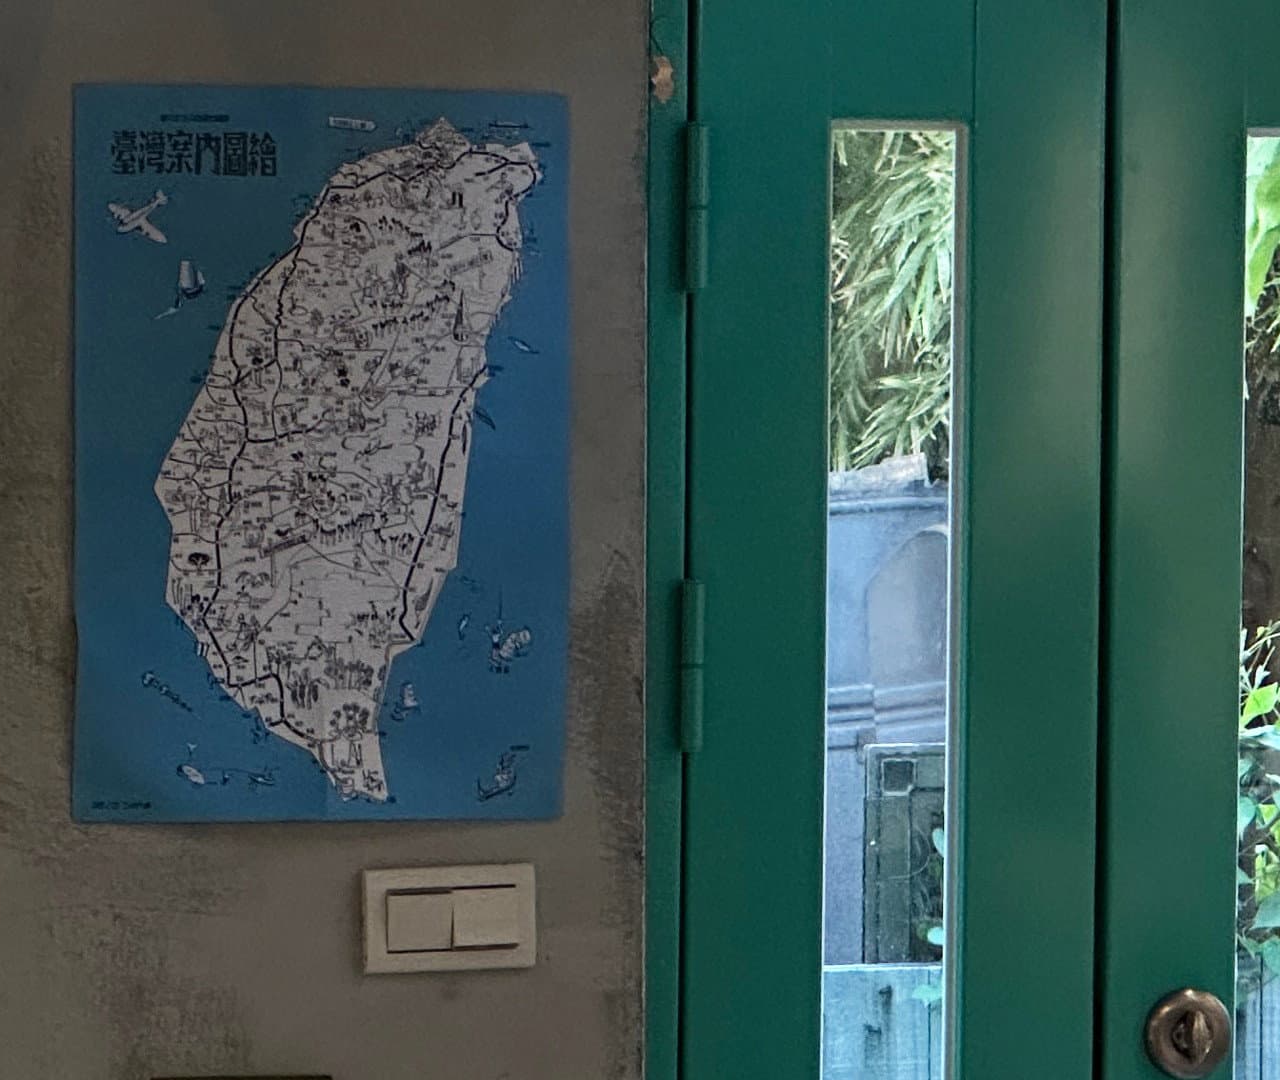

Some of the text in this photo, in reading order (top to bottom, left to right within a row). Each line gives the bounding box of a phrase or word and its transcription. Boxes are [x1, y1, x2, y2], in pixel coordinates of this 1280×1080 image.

[111, 130, 278, 177] 臺灣案內圖繪
